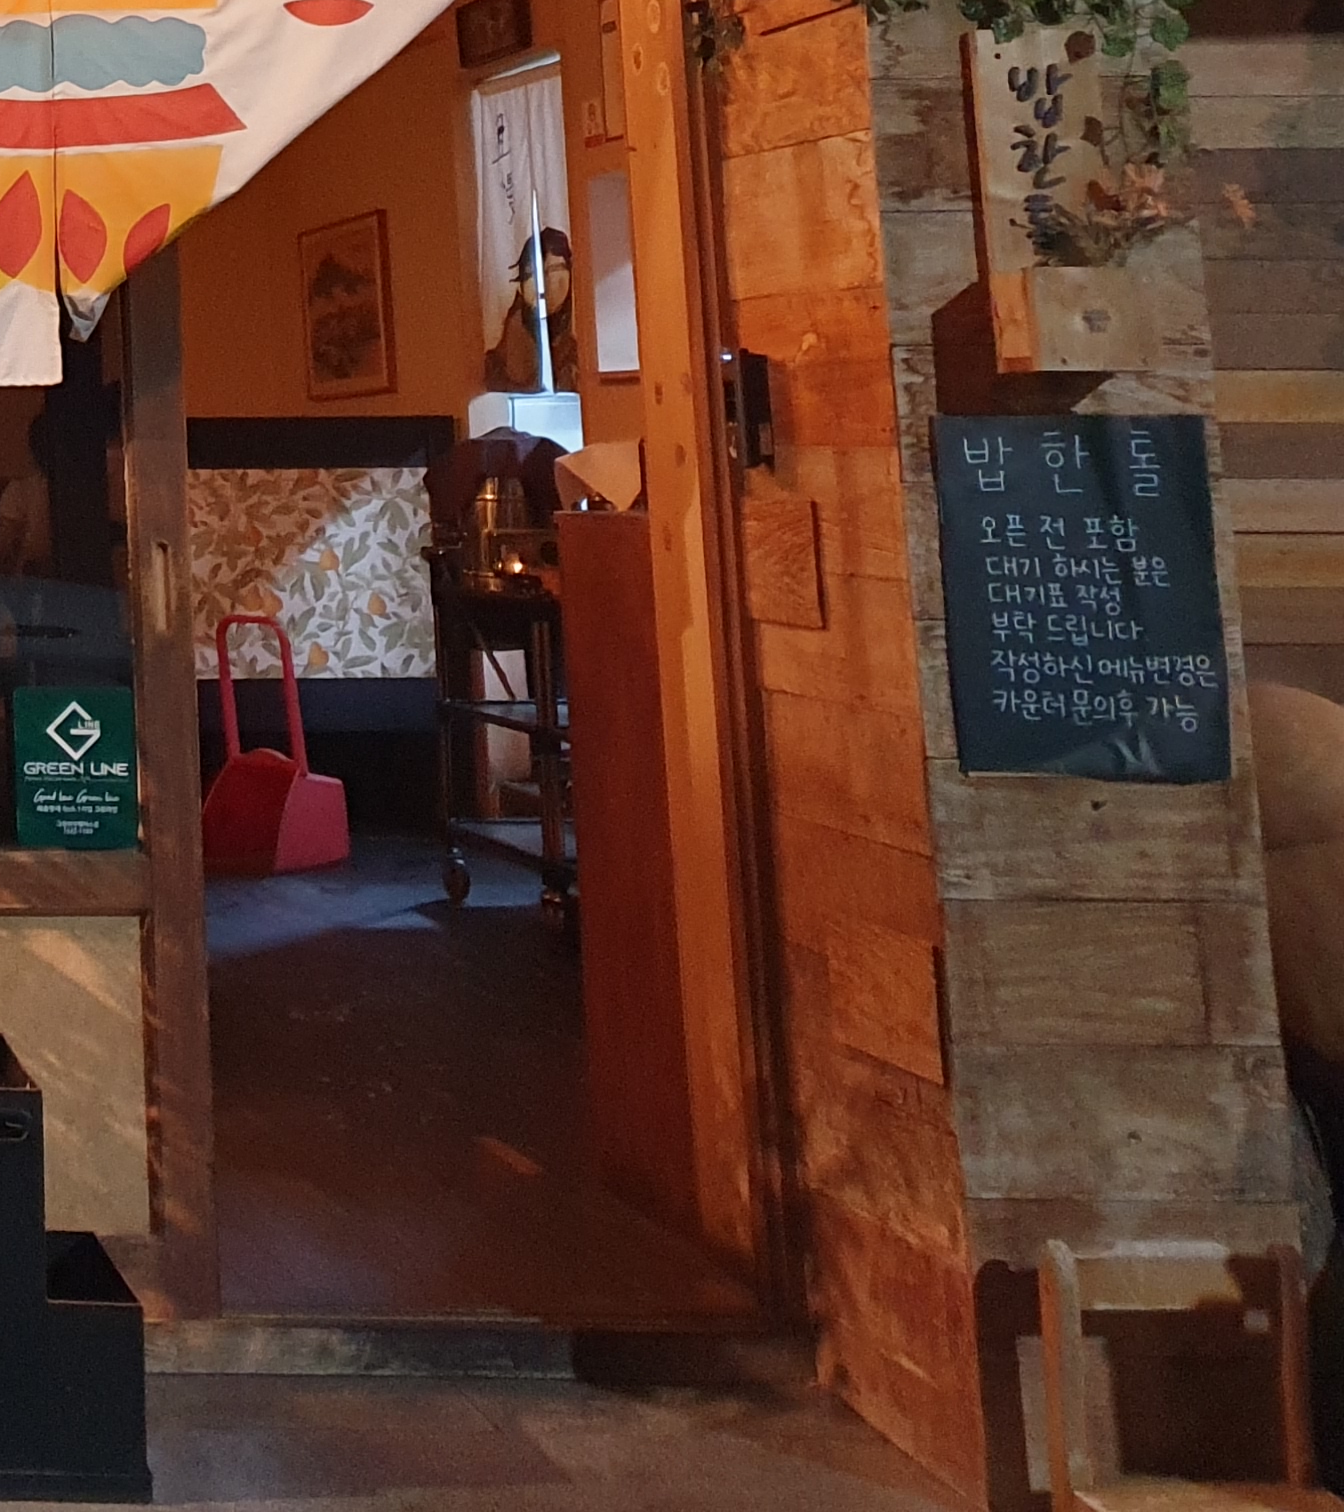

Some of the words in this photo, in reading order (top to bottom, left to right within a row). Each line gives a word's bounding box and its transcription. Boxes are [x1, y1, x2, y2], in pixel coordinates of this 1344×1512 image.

[980, 513, 1027, 548] 오픈
[1039, 515, 1066, 550] 전
[1083, 514, 1140, 552] 포함
[985, 555, 1041, 578] 대기
[1052, 553, 1122, 584] 하시는
[1132, 555, 1171, 587] 분은
[988, 582, 1069, 608] 대기표
[1076, 585, 1121, 616] 작성
[991, 611, 1036, 644] 부탁
[1047, 614, 1145, 646] 드립니다
[992, 690, 1066, 720] 카운터
[1146, 694, 1199, 732] 가능
[23, 761, 84, 776] GREEN
[90, 762, 129, 777] LINE
